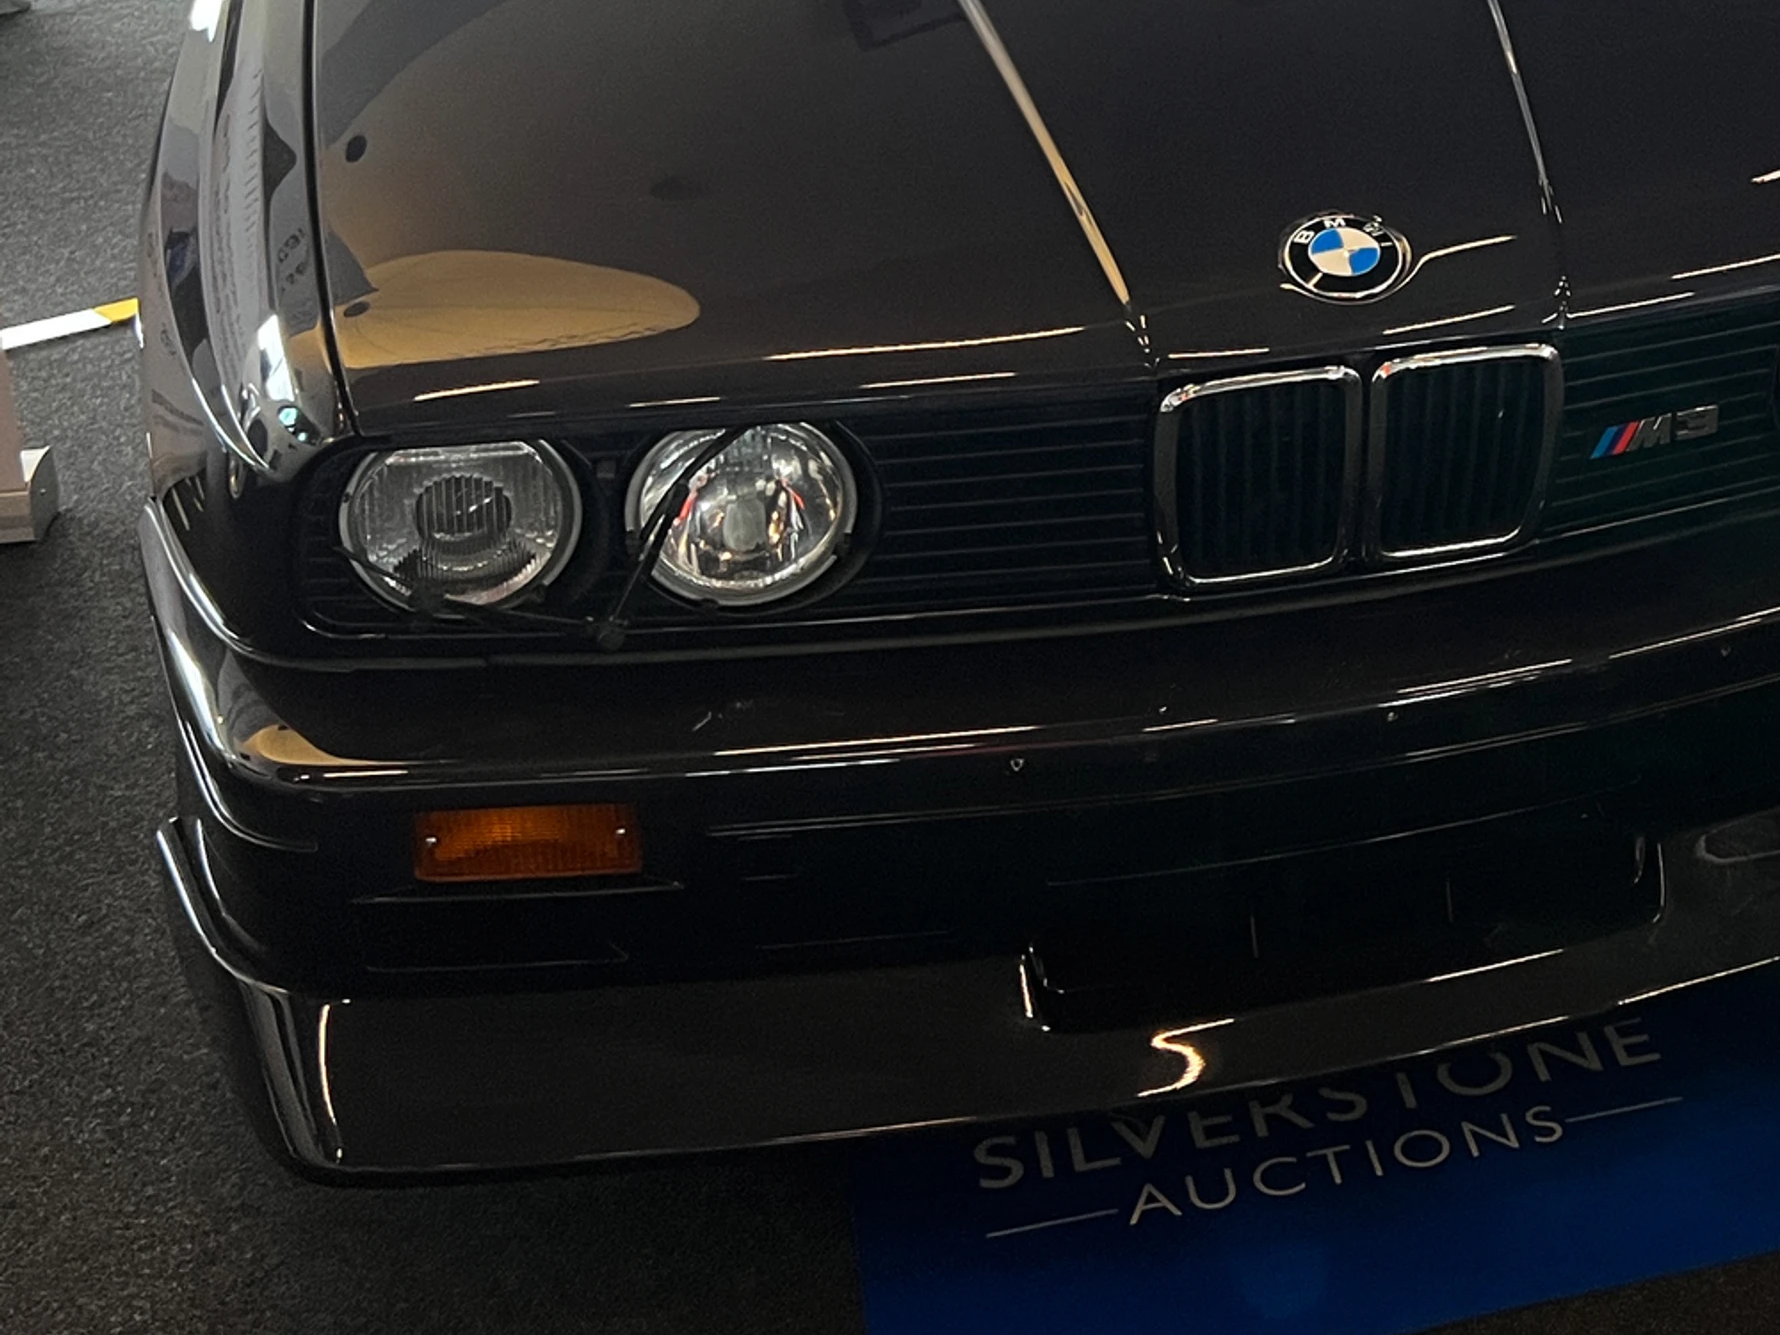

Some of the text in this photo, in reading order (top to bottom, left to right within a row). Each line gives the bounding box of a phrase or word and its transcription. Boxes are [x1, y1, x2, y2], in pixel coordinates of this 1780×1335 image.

[1293, 217, 1385, 245] BMW
[1624, 404, 1719, 452] M3
[1129, 1105, 1563, 1226] AUCTIONS
